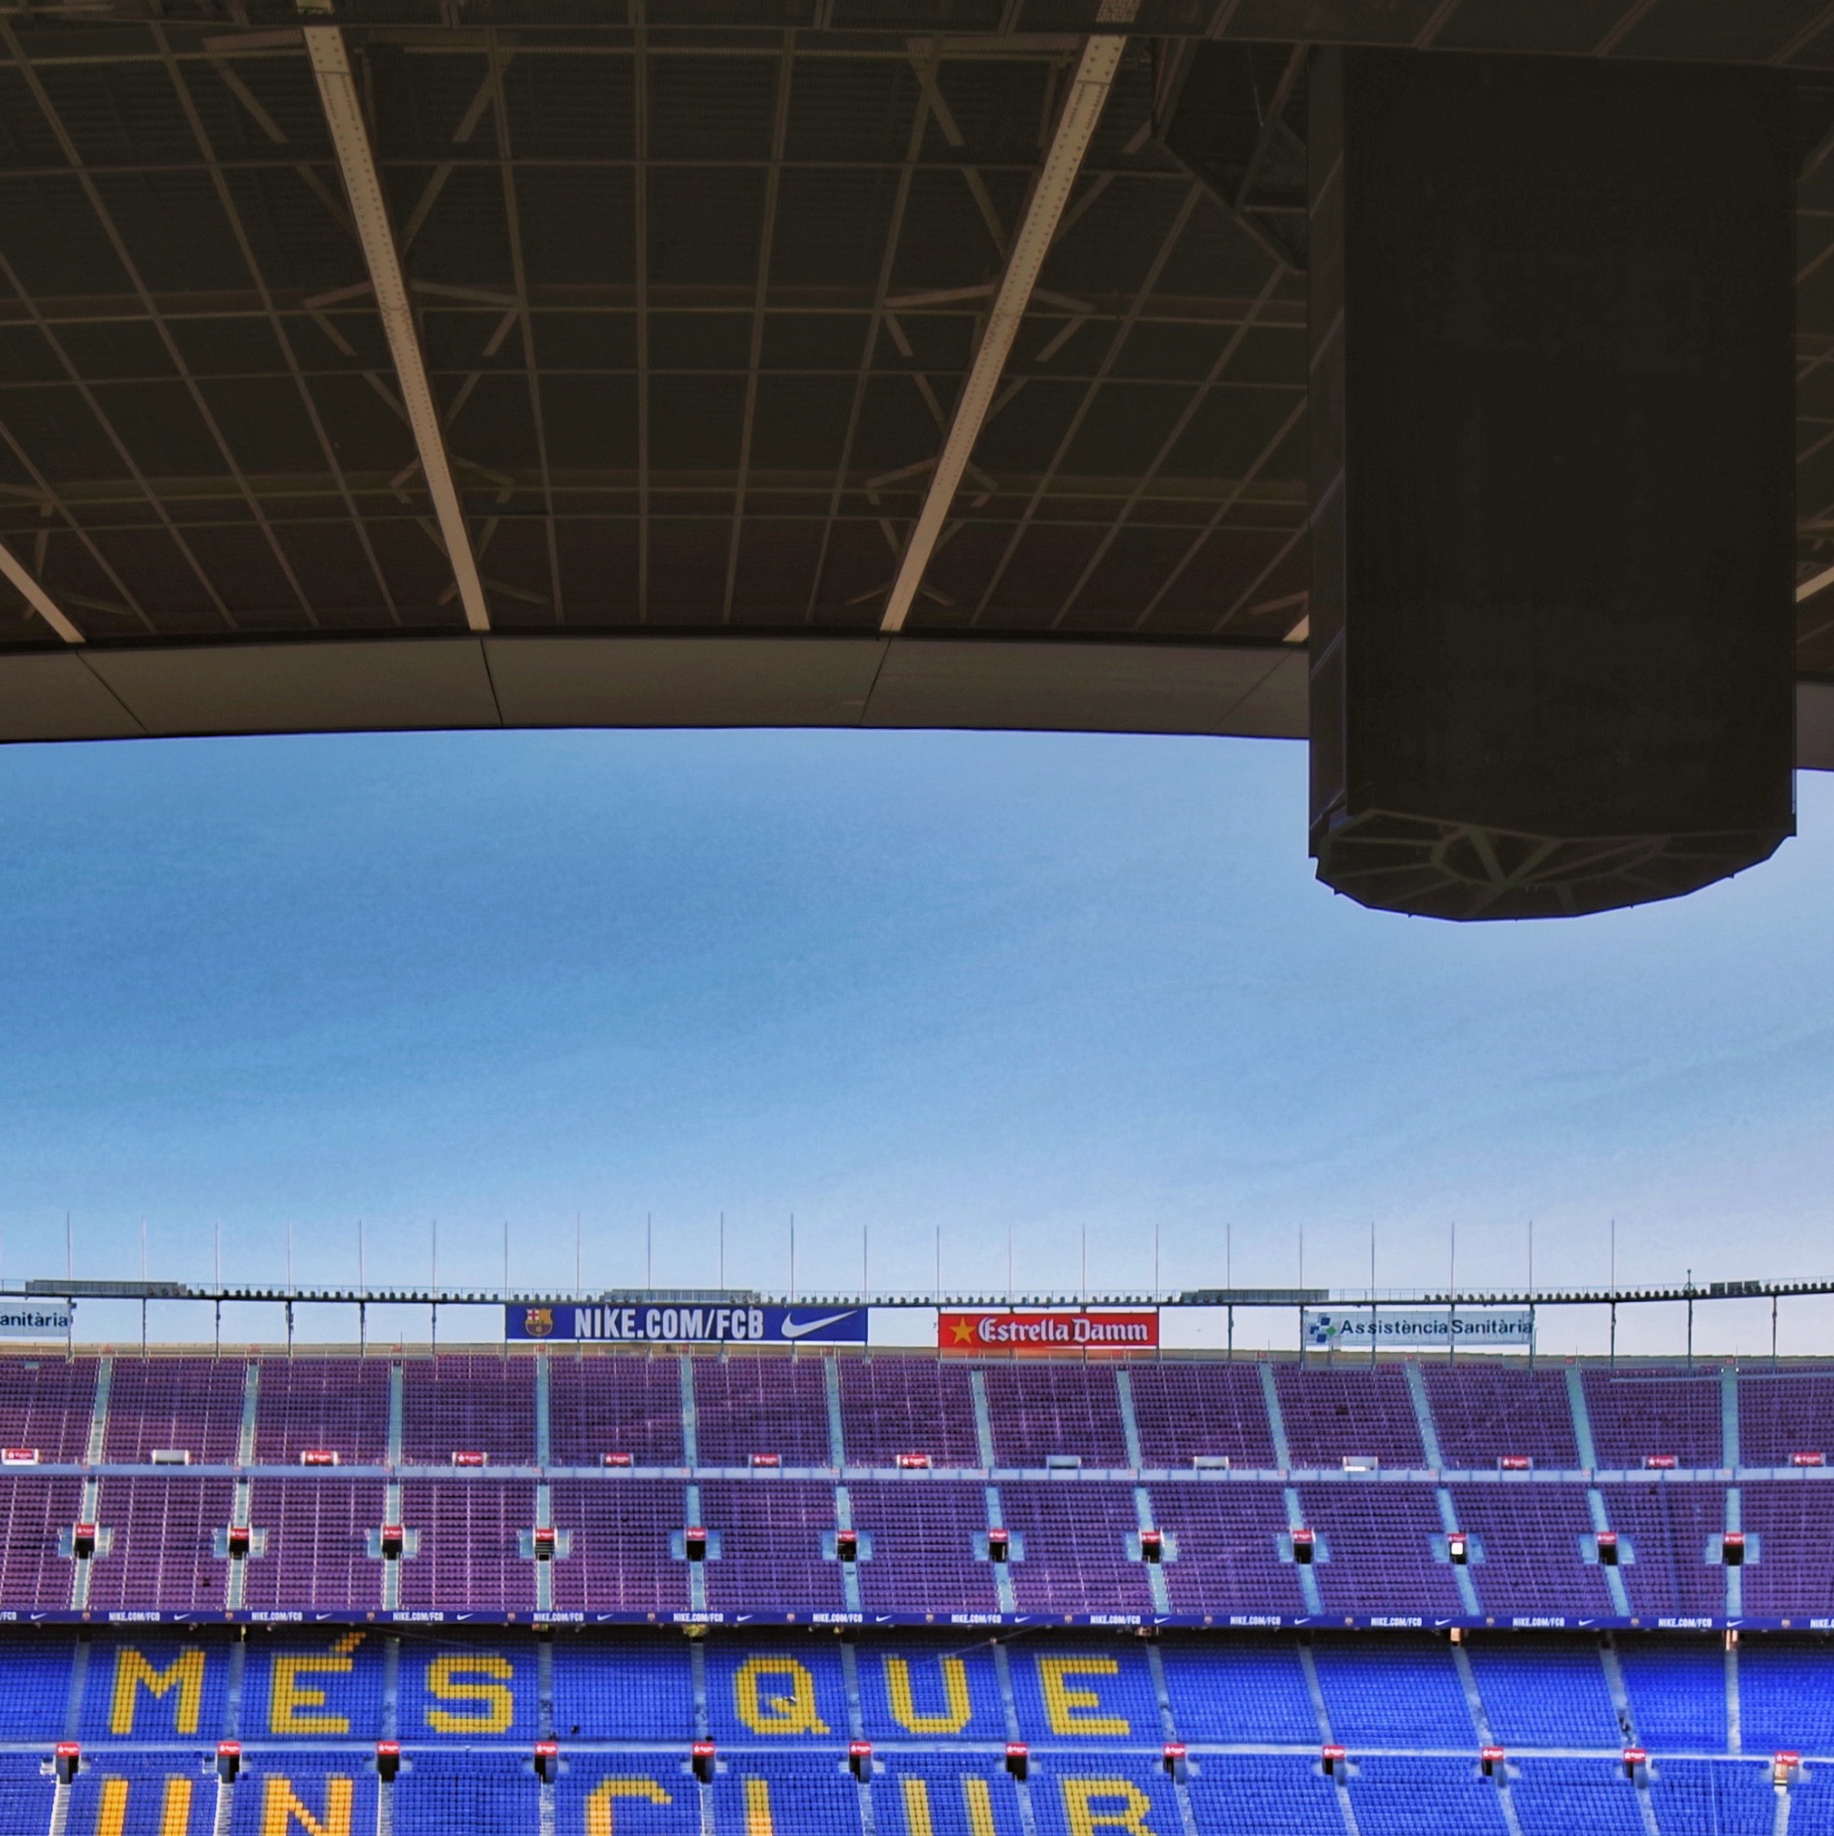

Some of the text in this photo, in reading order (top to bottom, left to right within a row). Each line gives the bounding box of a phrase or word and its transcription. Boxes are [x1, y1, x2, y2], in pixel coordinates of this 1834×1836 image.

[574, 1308, 765, 1340] NIKE.COM/FCB
[978, 1317, 1149, 1344] Estrella Damm
[1340, 1315, 1534, 1337] Assistència Sanitària
[110, 1632, 1130, 1735] MÉS QUE
